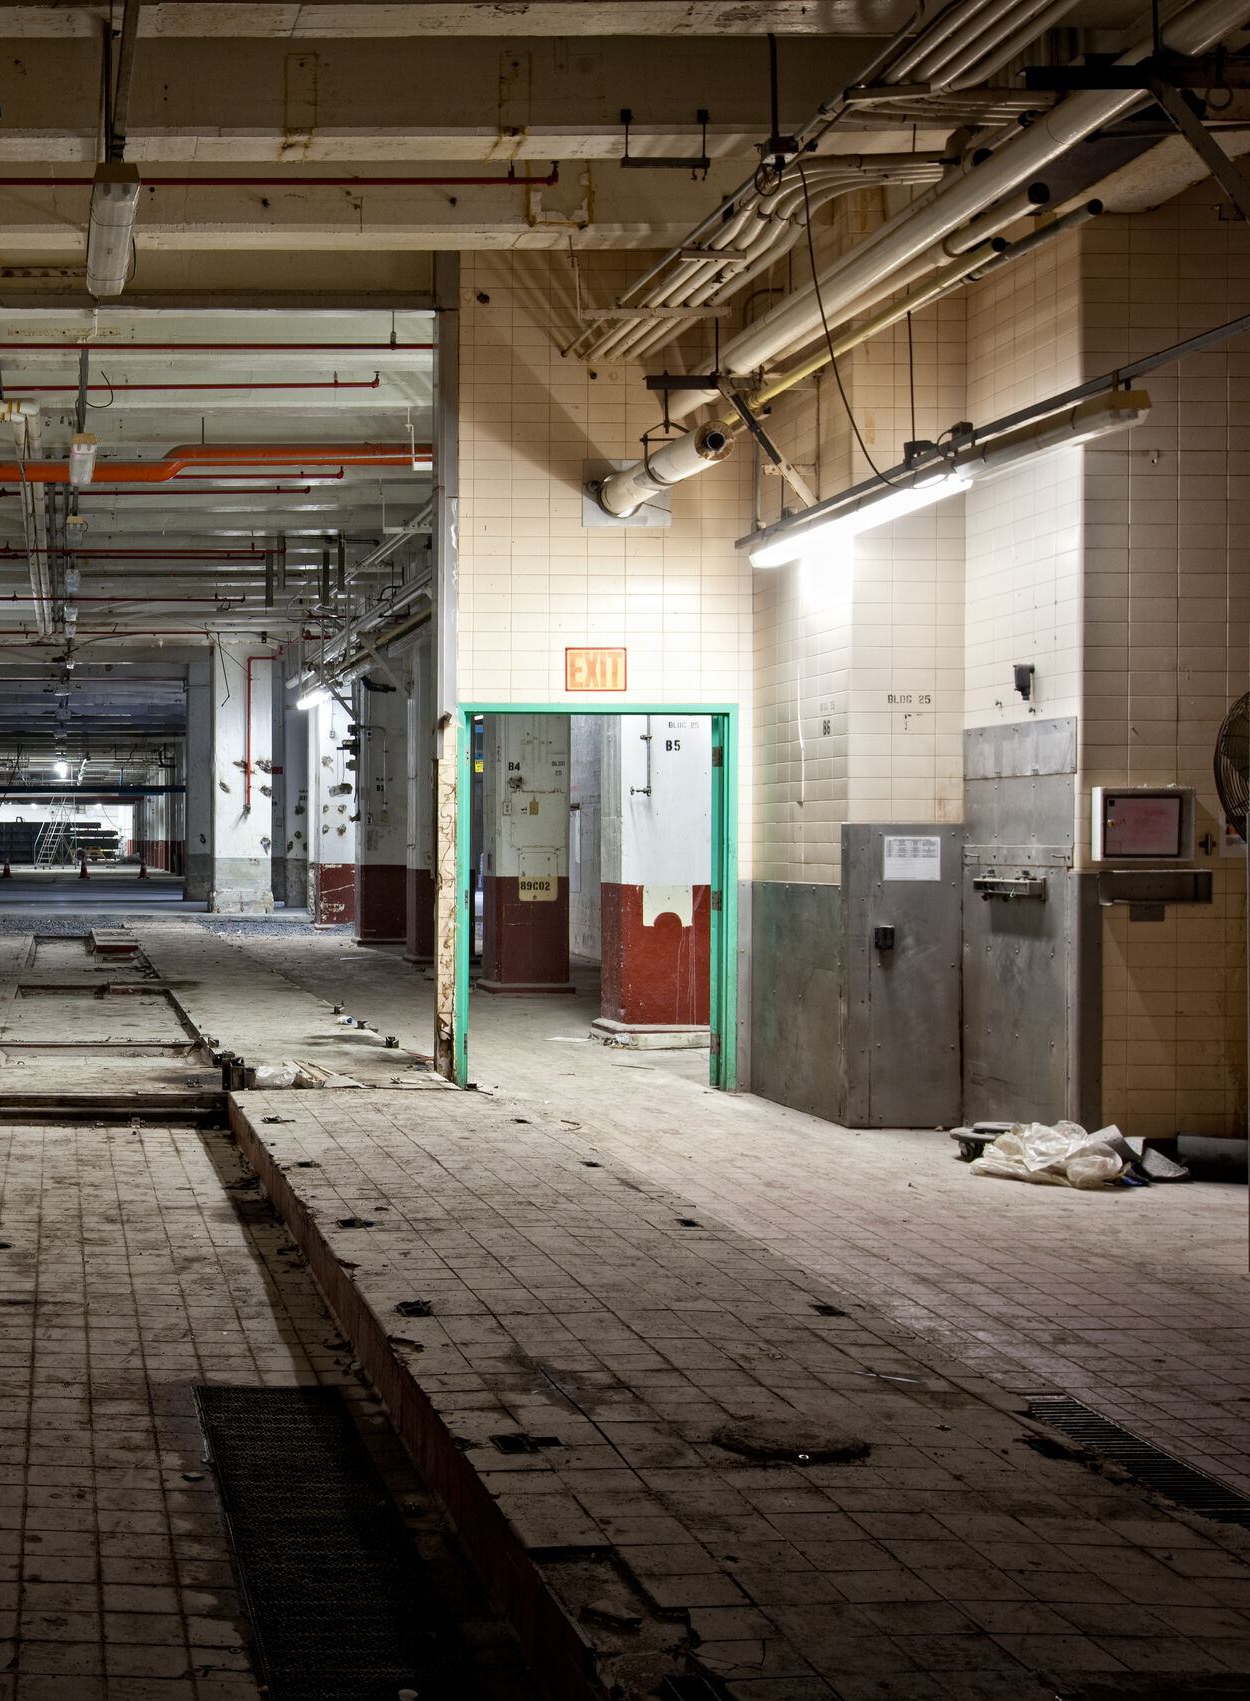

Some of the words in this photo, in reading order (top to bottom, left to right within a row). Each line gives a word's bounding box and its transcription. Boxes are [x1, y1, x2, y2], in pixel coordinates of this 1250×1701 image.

[568, 651, 623, 688] EXIT
[887, 694, 912, 704] BLDG
[918, 694, 931, 704] 25
[822, 719, 831, 736] B6
[665, 739, 681, 752] B5
[508, 761, 520, 771] B4
[520, 881, 551, 891] 89C02
